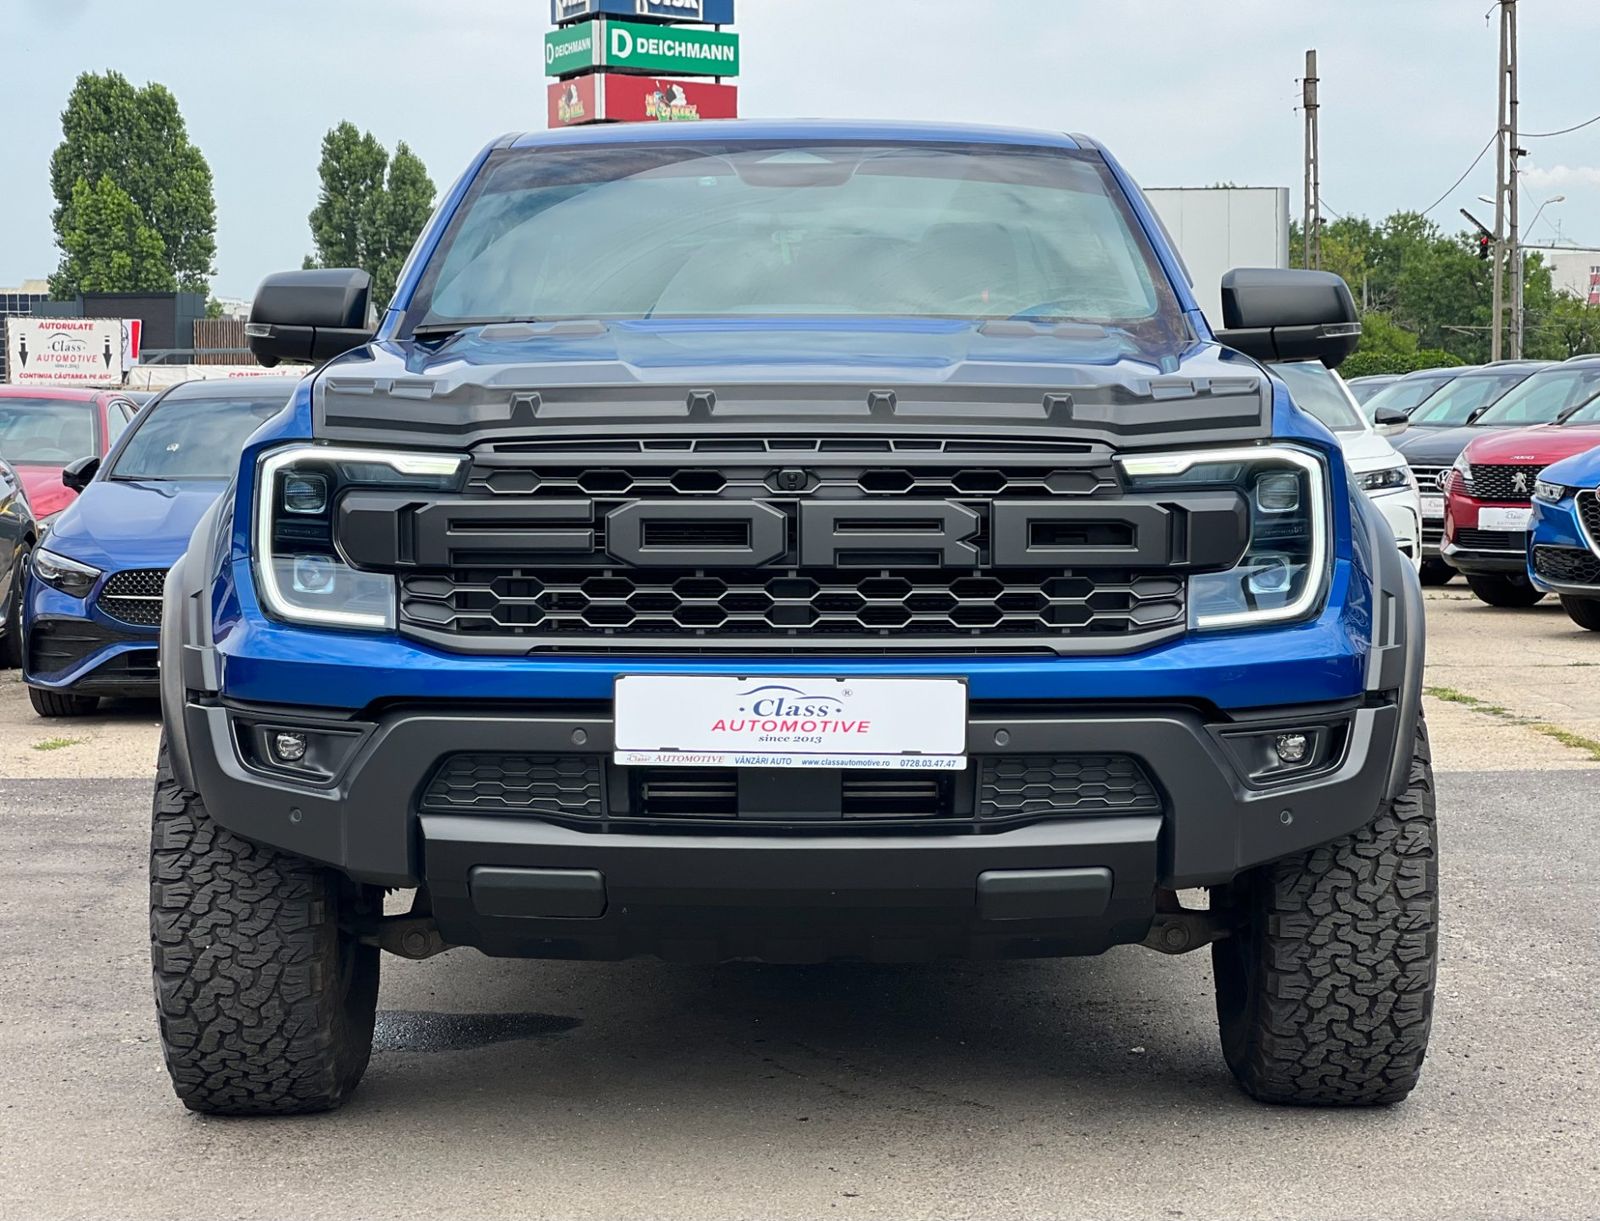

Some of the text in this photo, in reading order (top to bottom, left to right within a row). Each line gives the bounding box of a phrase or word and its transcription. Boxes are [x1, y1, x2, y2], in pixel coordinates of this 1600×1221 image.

[555, 37, 591, 58] DEICHMANN
[611, 28, 734, 61] D DEICHMANN
[38, 322, 94, 331] AUTORULATE
[51, 341, 82, 352] Class
[36, 354, 97, 363] AUTOMOTIVE
[415, 498, 1171, 569] FORD
[753, 698, 829, 717] Class
[711, 719, 871, 733] AUTOMOTIVE
[758, 734, 823, 744] since 2013
[655, 754, 725, 763] AUTOMOTIVE
[770, 757, 792, 765] AUTO
[801, 758, 891, 767] www.classautomotive.ro
[899, 759, 957, 768] 0728.03.47.47
